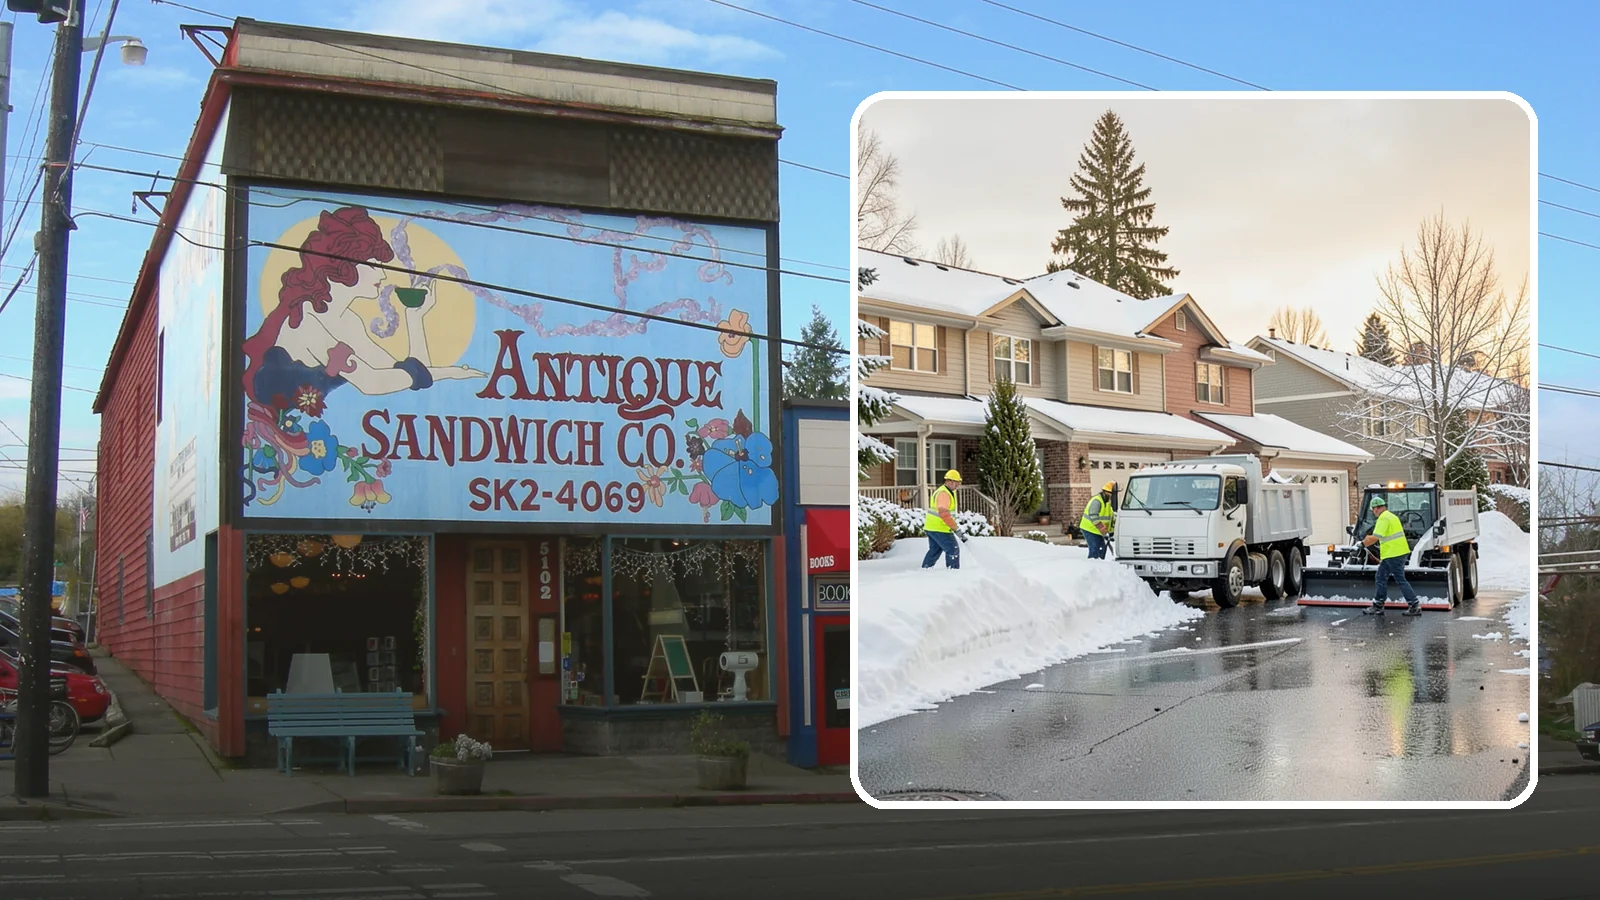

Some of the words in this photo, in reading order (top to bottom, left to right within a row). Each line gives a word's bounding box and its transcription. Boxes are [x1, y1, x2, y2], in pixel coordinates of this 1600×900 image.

[476, 329, 723, 421] ANTIQUE
[361, 409, 604, 467] SANDWICH
[617, 422, 684, 468] CO.
[468, 477, 645, 513] SK2-4069
[539, 542, 552, 600] 5102
[809, 555, 835, 569] BOOKS
